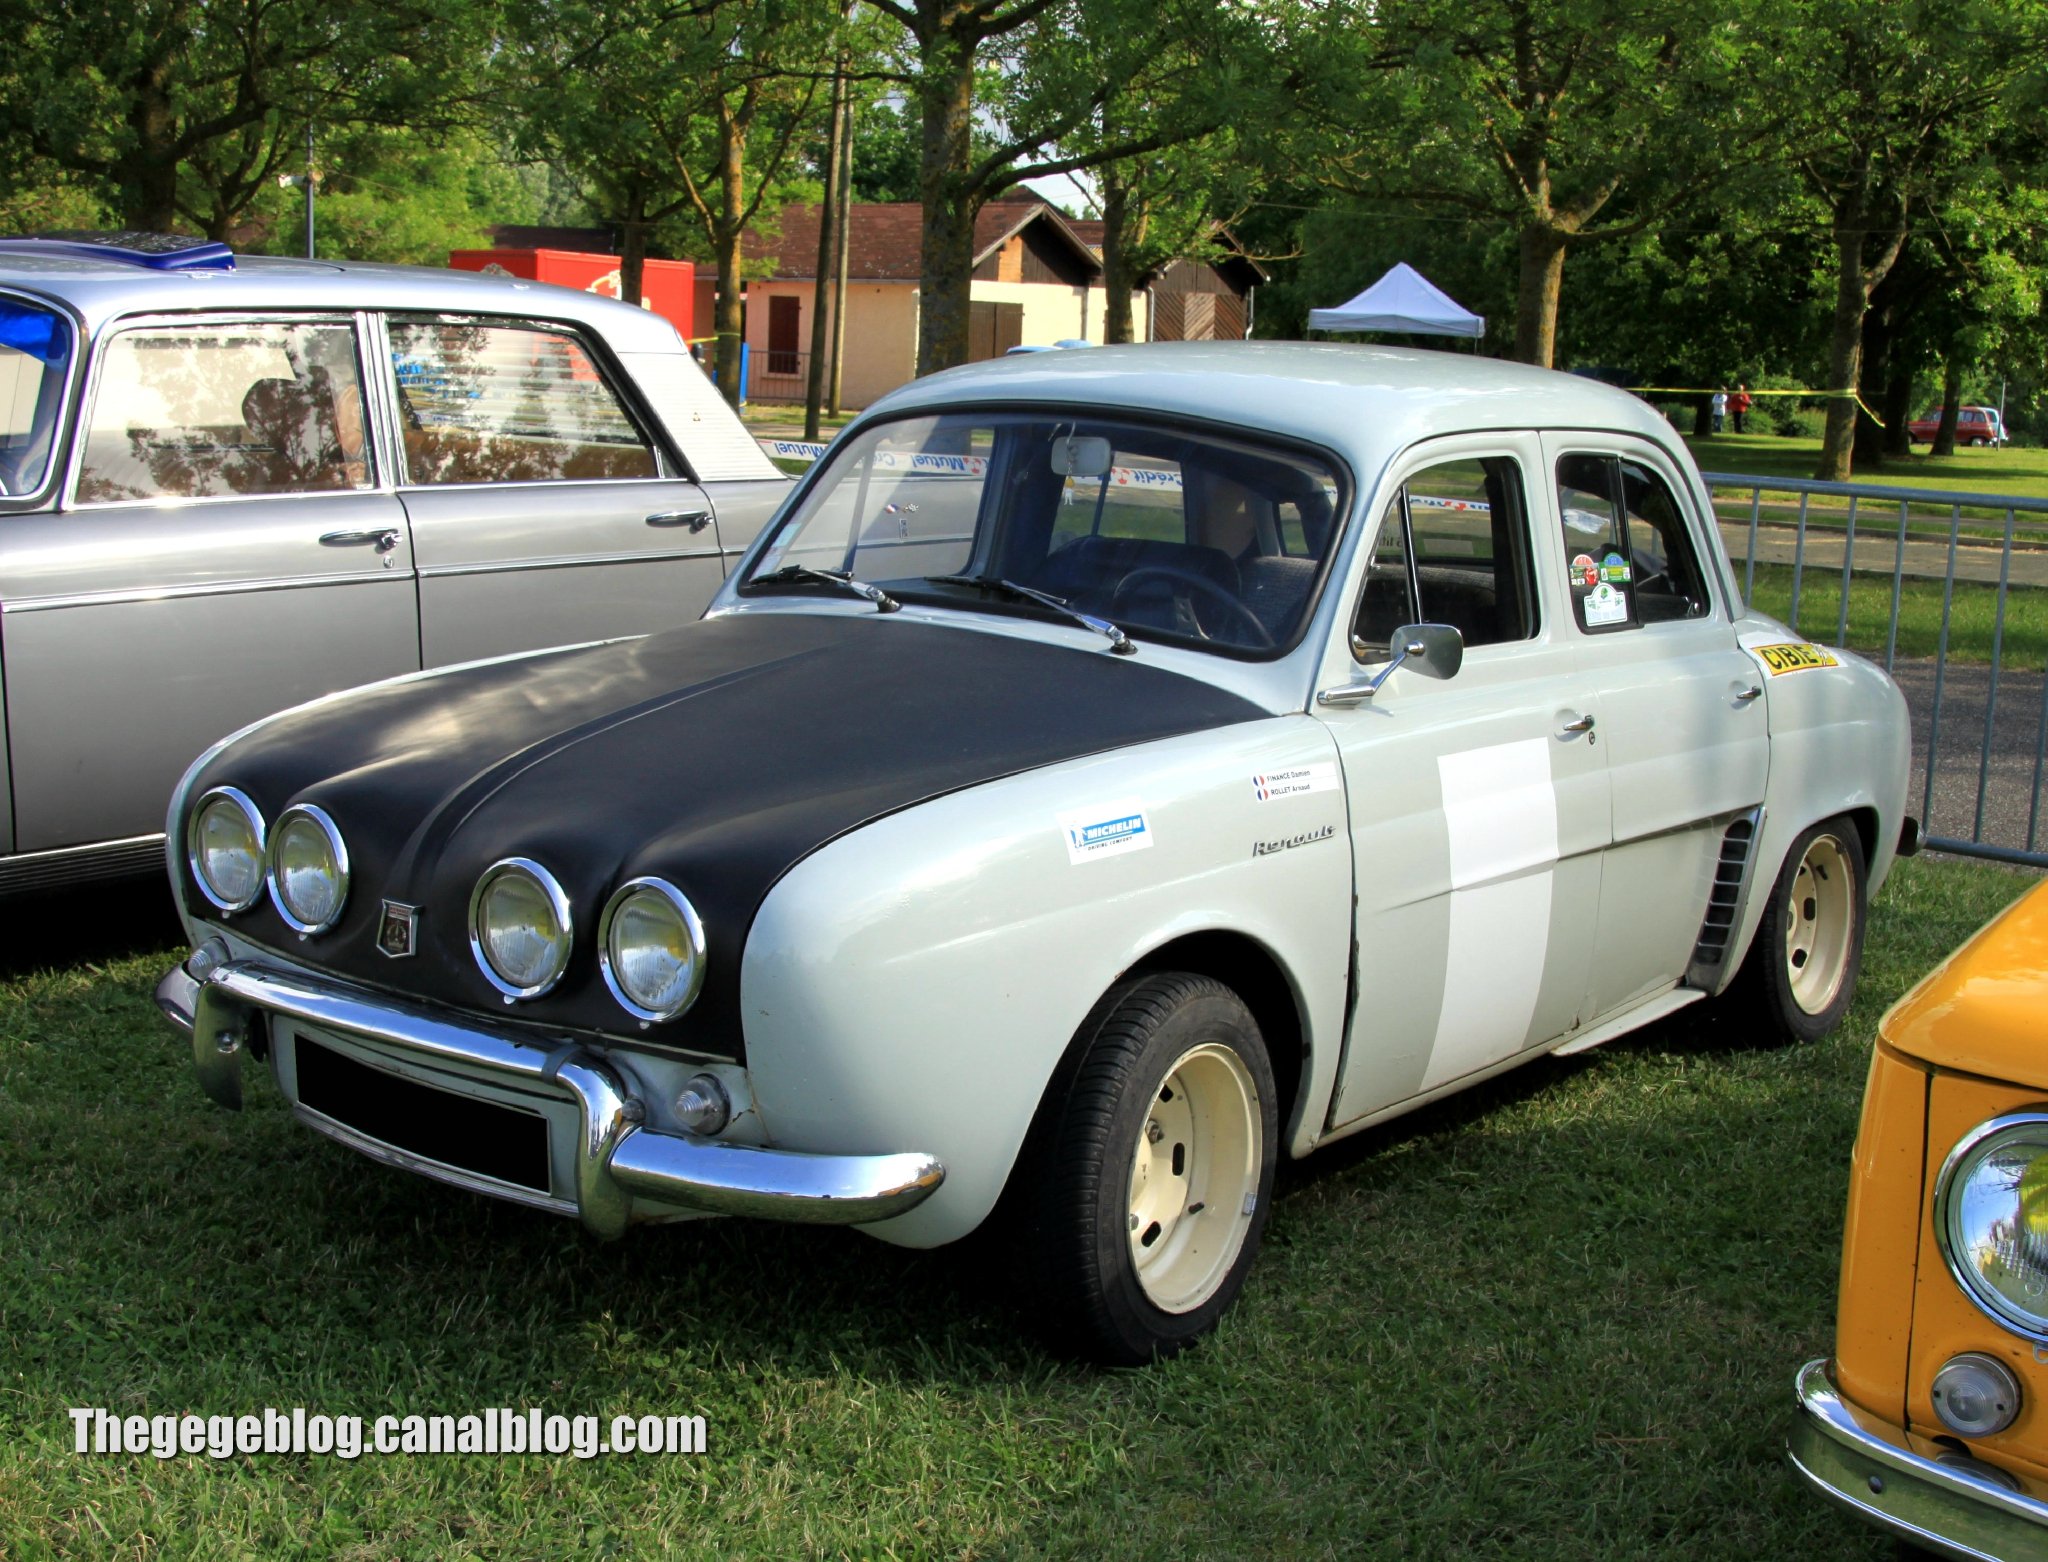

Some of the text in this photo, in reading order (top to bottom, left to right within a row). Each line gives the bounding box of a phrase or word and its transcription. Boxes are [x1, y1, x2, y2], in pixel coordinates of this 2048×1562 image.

[912, 453, 966, 471] Mutuel
[1267, 770, 1311, 782] FINANCE Damien
[1271, 786, 1291, 796] ROLLET
[1087, 817, 1142, 839] MICHELIN
[1252, 825, 1336, 857] Renault
